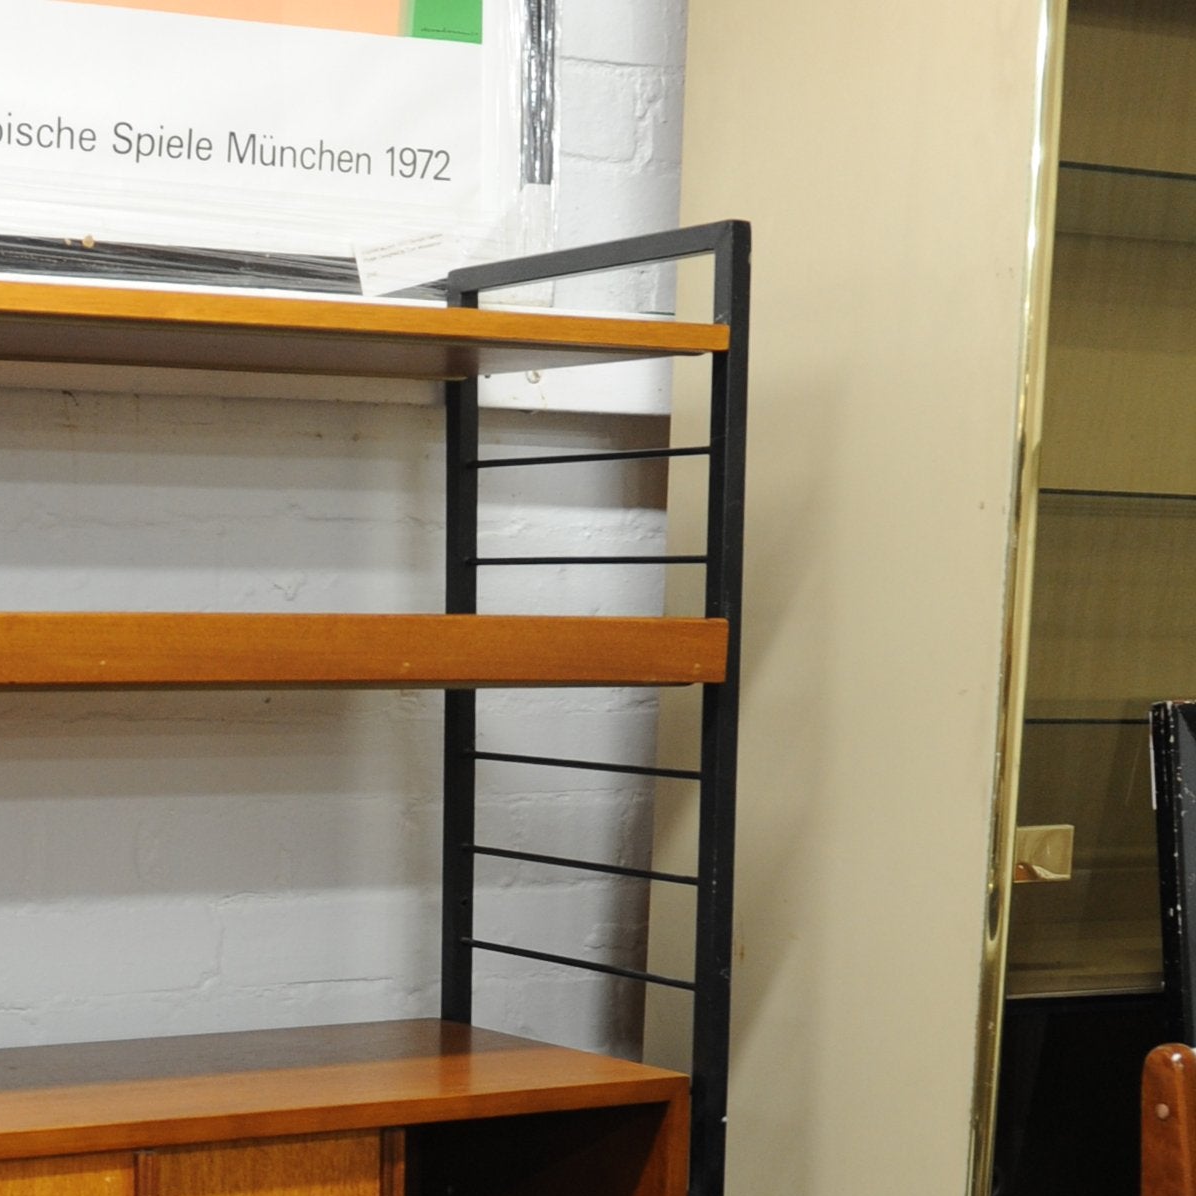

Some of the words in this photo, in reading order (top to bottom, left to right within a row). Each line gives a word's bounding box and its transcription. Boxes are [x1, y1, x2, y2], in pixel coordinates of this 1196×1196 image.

[112, 121, 213, 164] Spiele
[227, 131, 371, 175] München
[386, 146, 451, 182] 1972
